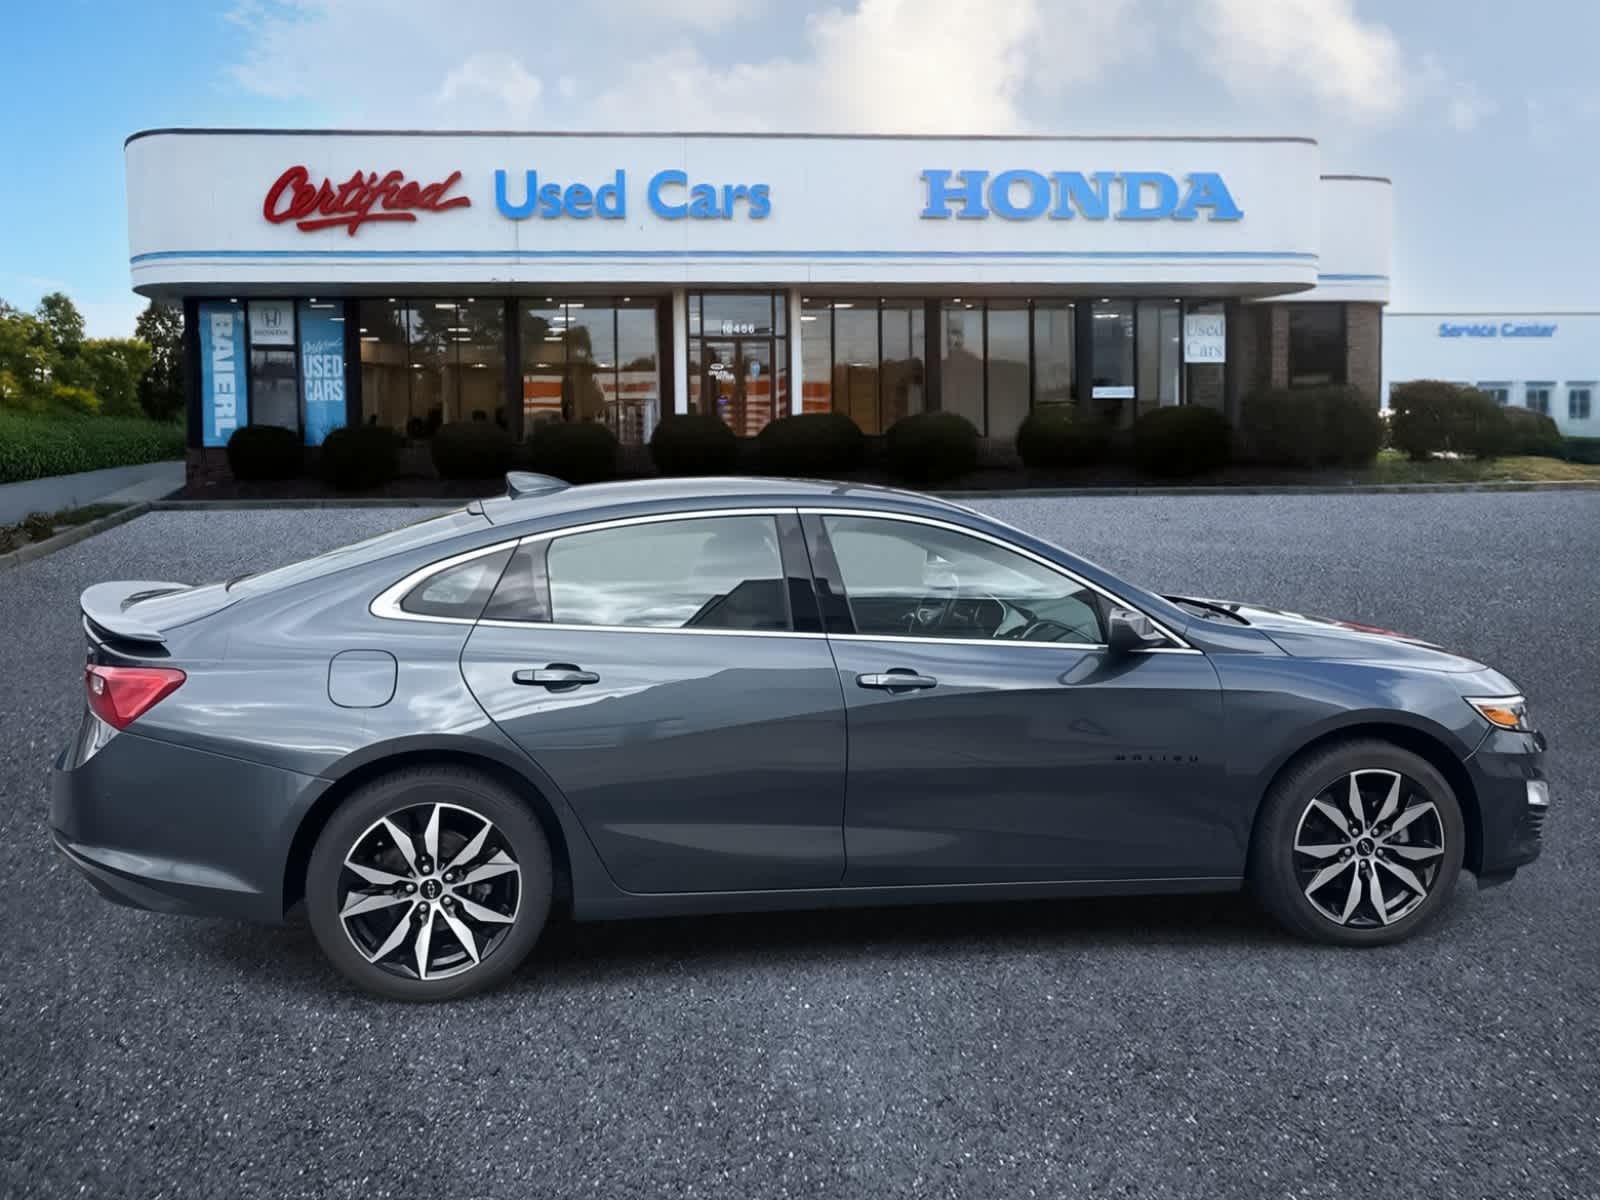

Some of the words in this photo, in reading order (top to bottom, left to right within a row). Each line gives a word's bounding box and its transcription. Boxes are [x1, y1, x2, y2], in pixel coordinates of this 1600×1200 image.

[264, 165, 471, 236] Certified
[495, 169, 626, 220] Used
[648, 169, 771, 220] Cars
[920, 169, 1244, 221] HONDA
[1186, 318, 1224, 336] Used
[1186, 341, 1224, 358] Cars
[210, 312, 237, 437] BAIERL
[302, 354, 342, 378] USED
[304, 379, 344, 402] CARS
